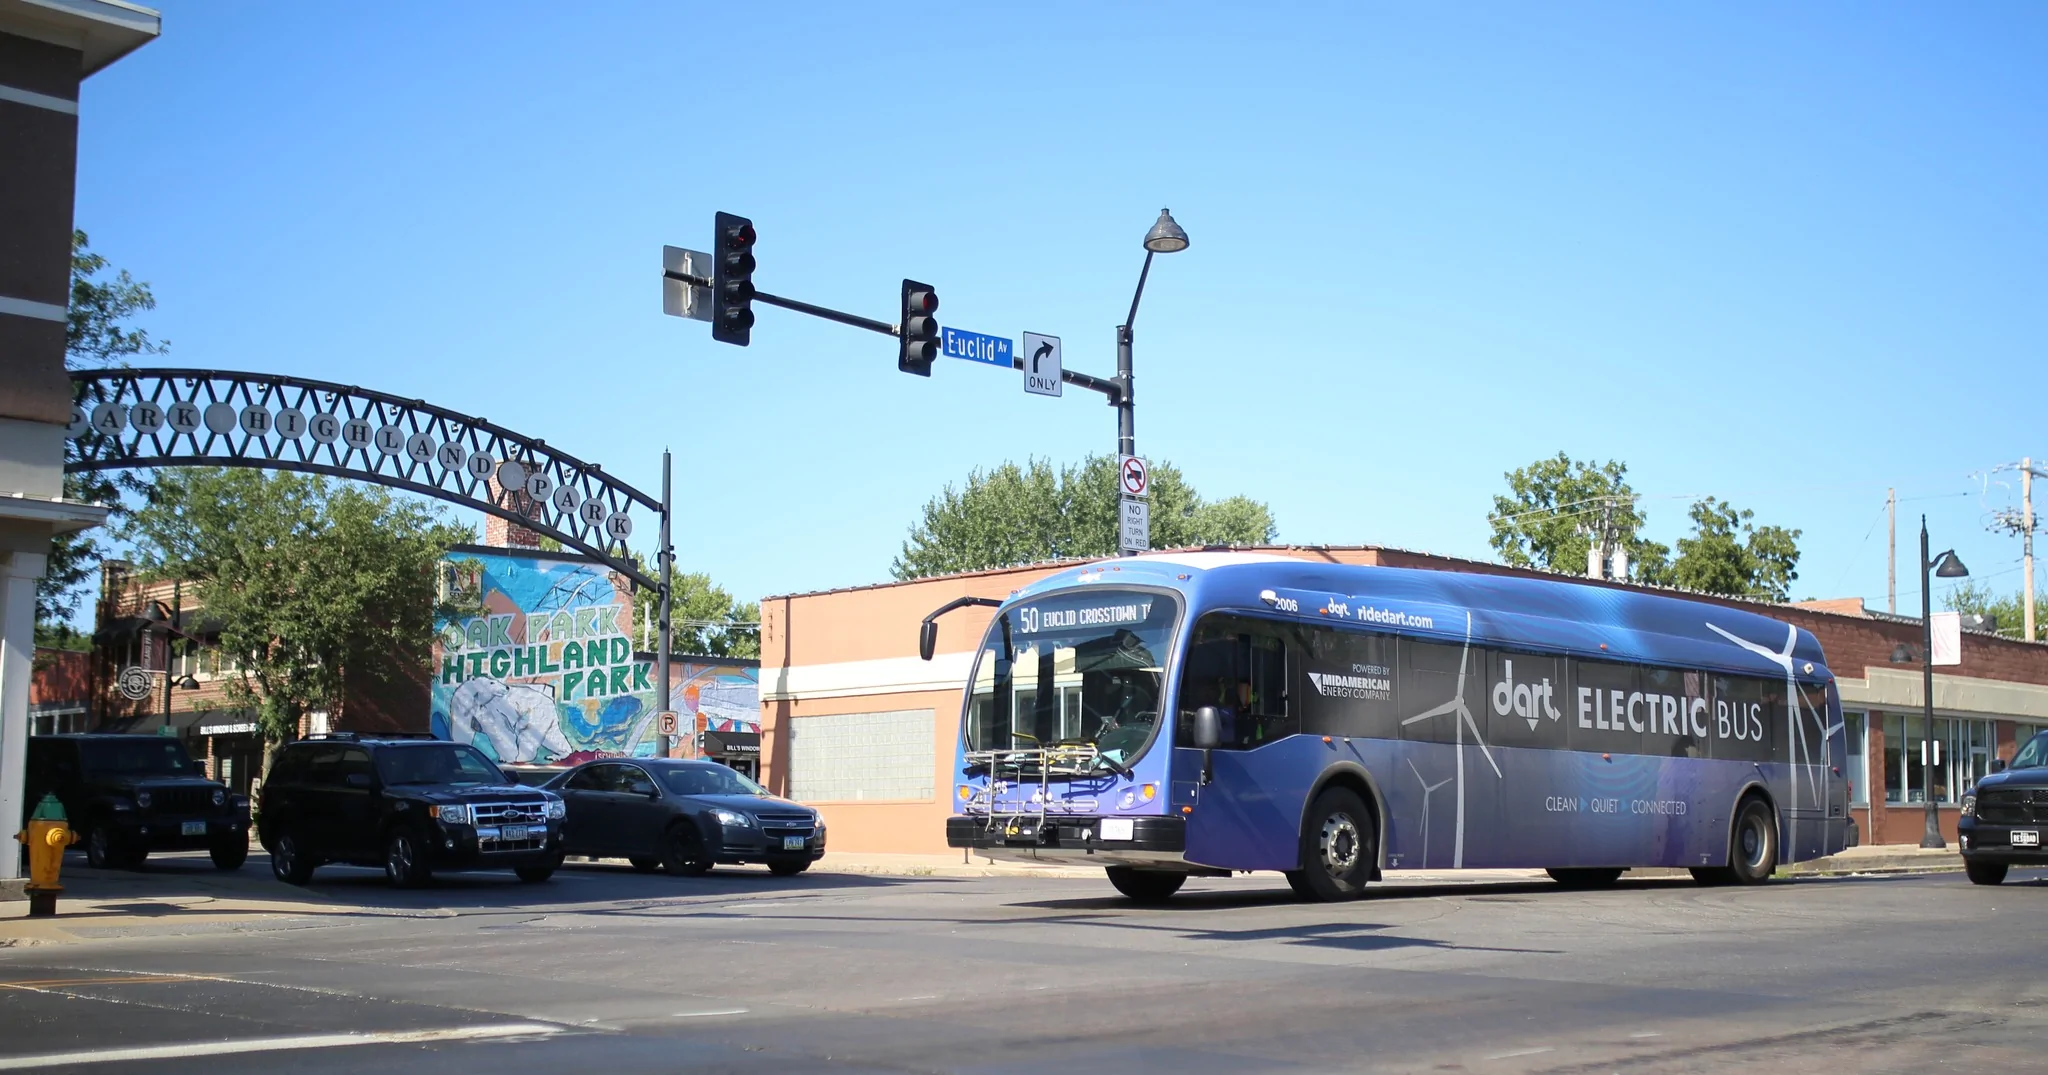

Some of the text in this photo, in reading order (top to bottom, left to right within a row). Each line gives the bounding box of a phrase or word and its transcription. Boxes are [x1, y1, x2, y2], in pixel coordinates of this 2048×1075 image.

[947, 331, 1008, 362] Euclid Av
[1029, 376, 1057, 391] ONLY
[65, 407, 627, 535] PARK HIGHLAND PARK
[1128, 505, 1142, 516] NO
[1127, 516, 1143, 526] RIGHT
[1128, 527, 1143, 537] TURN
[1124, 537, 1147, 548] ON RED
[1275, 597, 1298, 613] 2006
[1327, 597, 1433, 629] dart ridedart.com
[444, 606, 620, 650] OAK PARK
[1020, 606, 1039, 634] 50
[1043, 607, 1077, 628] EUCLID
[1079, 605, 1137, 625] CROSSTOWN
[442, 636, 630, 685] HIGHLAND
[1352, 663, 1390, 676] POWERED BY
[563, 662, 652, 701] PARK
[1322, 673, 1390, 691] MIDAMERICAN
[1322, 688, 1390, 701] ENERGY COMPANY
[1493, 659, 1561, 731] dart
[1578, 686, 1763, 742] ELECTRIC BUS
[1545, 796, 1687, 815] CLEAN QUIET CONNECTED
